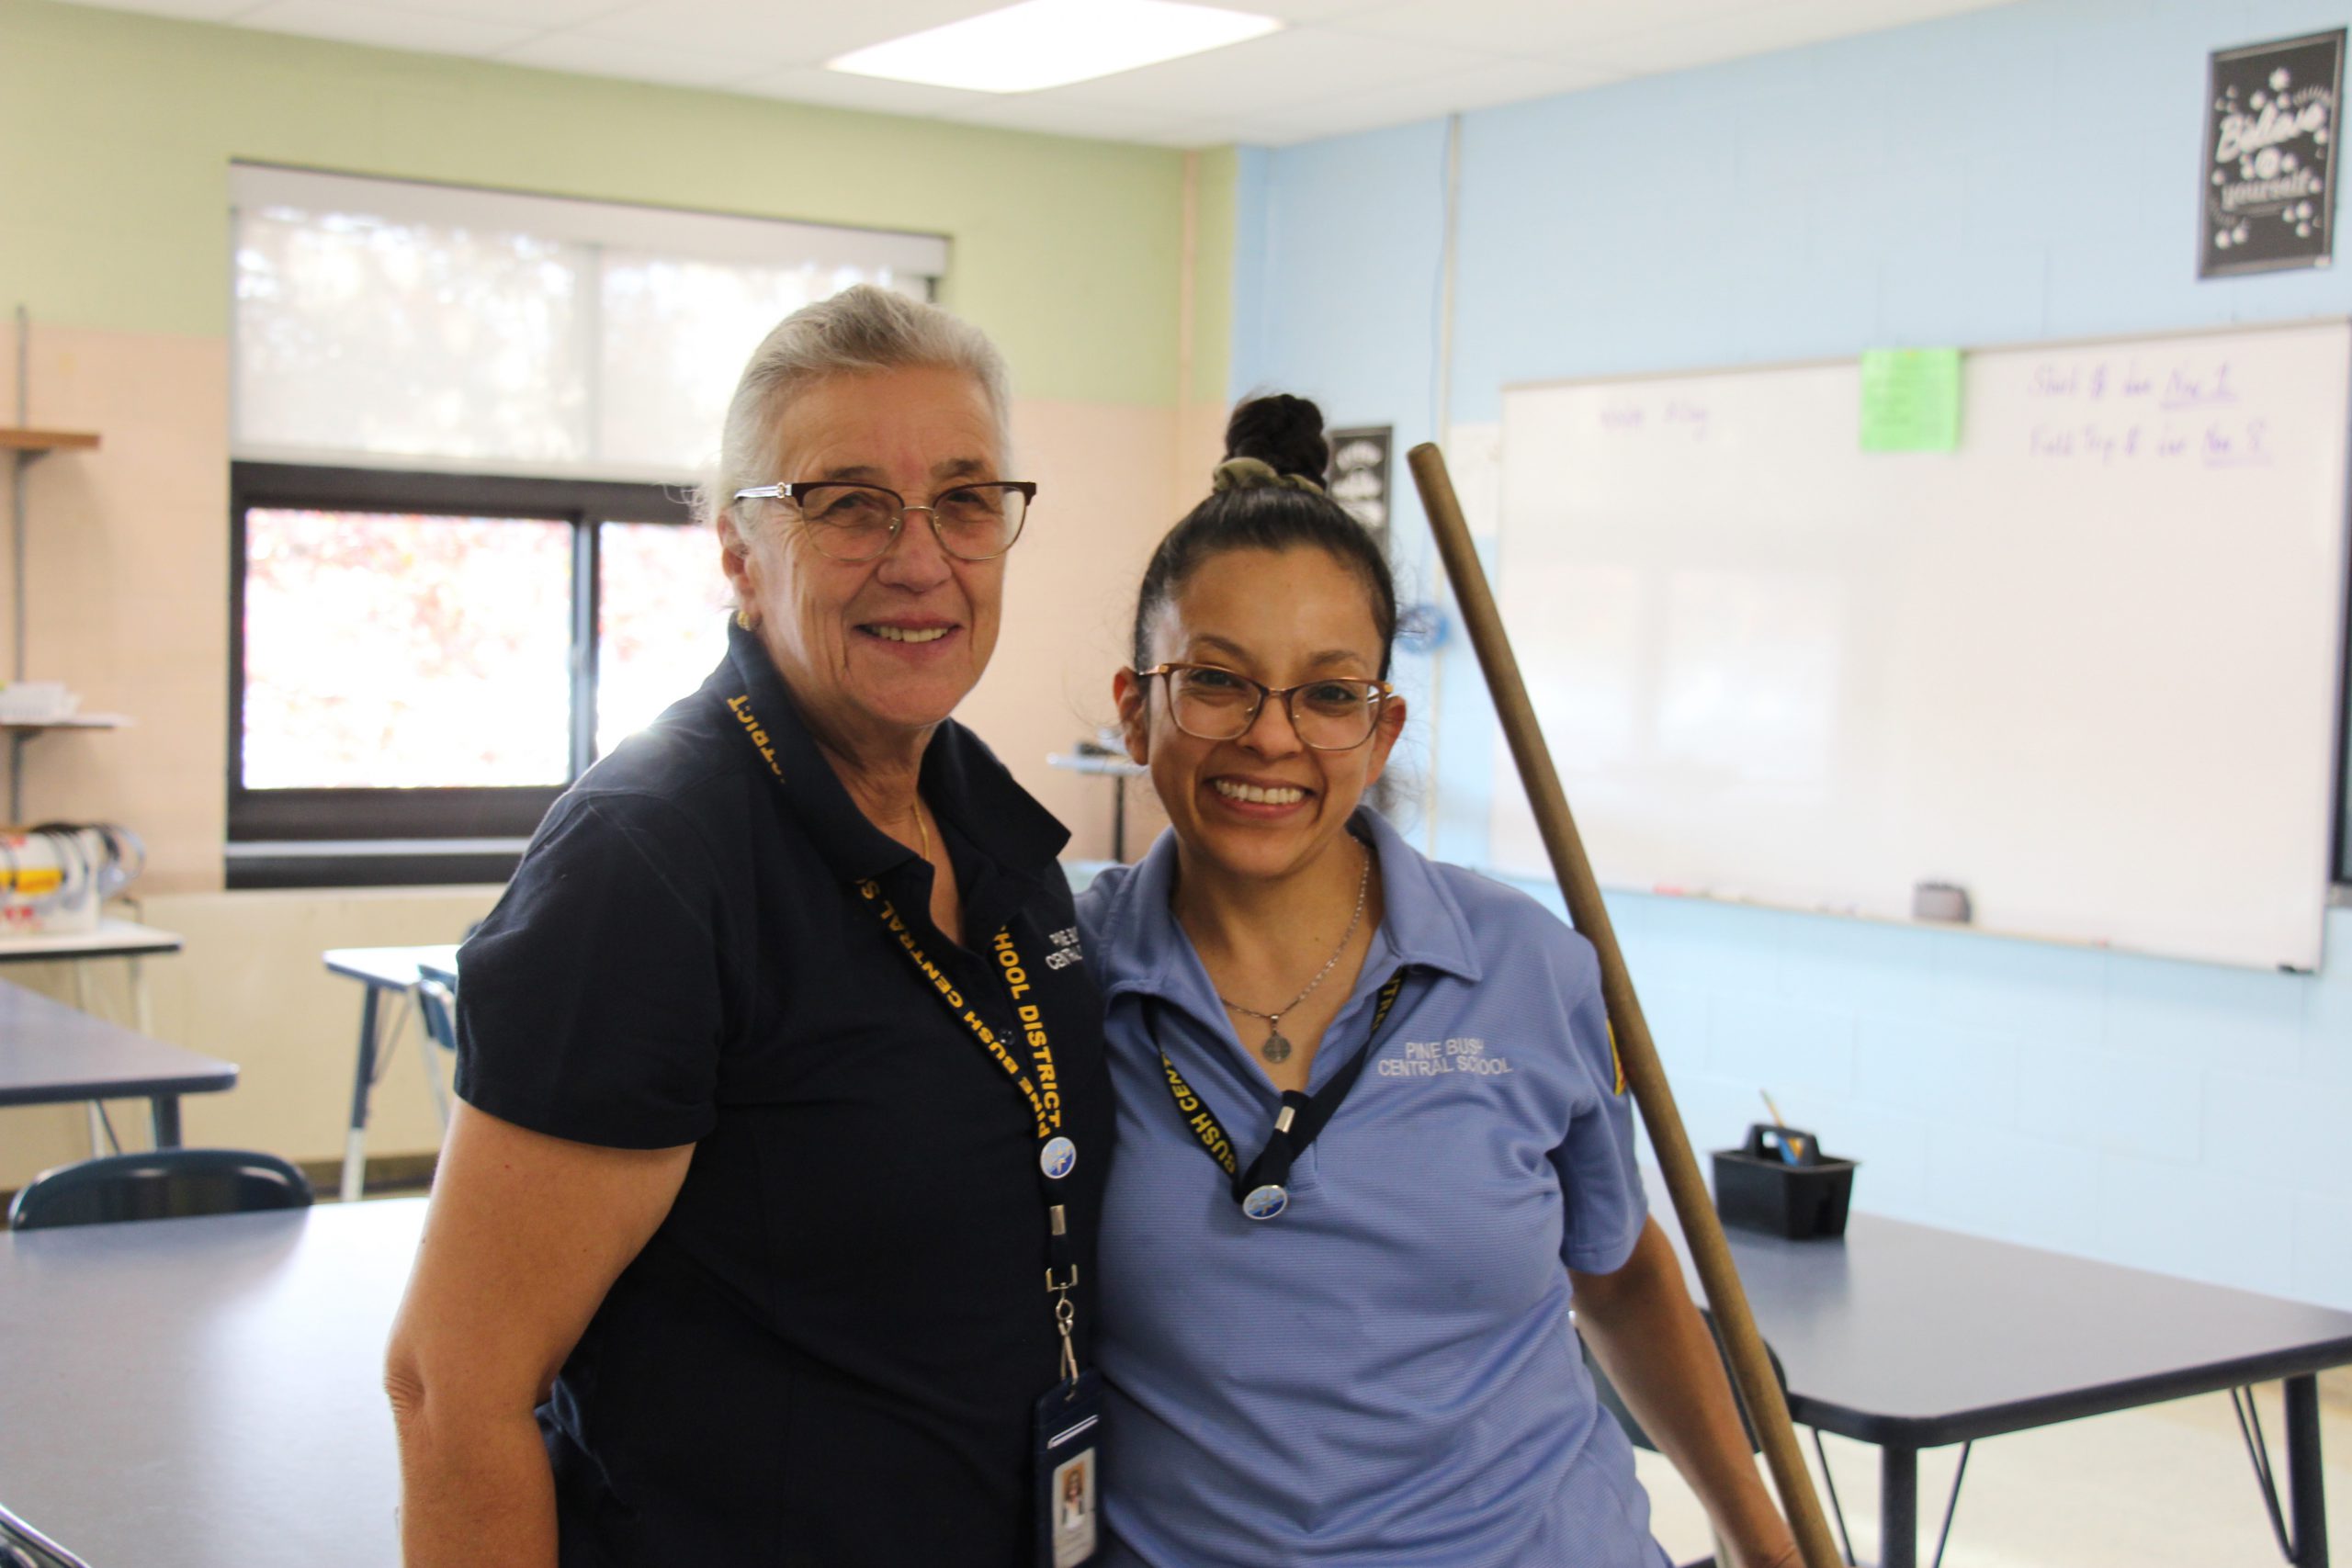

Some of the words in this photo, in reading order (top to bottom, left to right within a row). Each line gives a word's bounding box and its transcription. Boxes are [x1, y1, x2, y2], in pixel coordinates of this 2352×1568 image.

[880, 900, 964, 1009] CENTRAL
[963, 1010, 1019, 1074] BUSH
[992, 925, 1030, 999] HOOL
[1018, 1005, 1061, 1128] DISTRICT
[1405, 1042, 1443, 1059] PINE
[1378, 1057, 1455, 1077] CENTRAL
[1457, 1055, 1514, 1076] SCOOL
[1019, 1077, 1050, 1139] PINE
